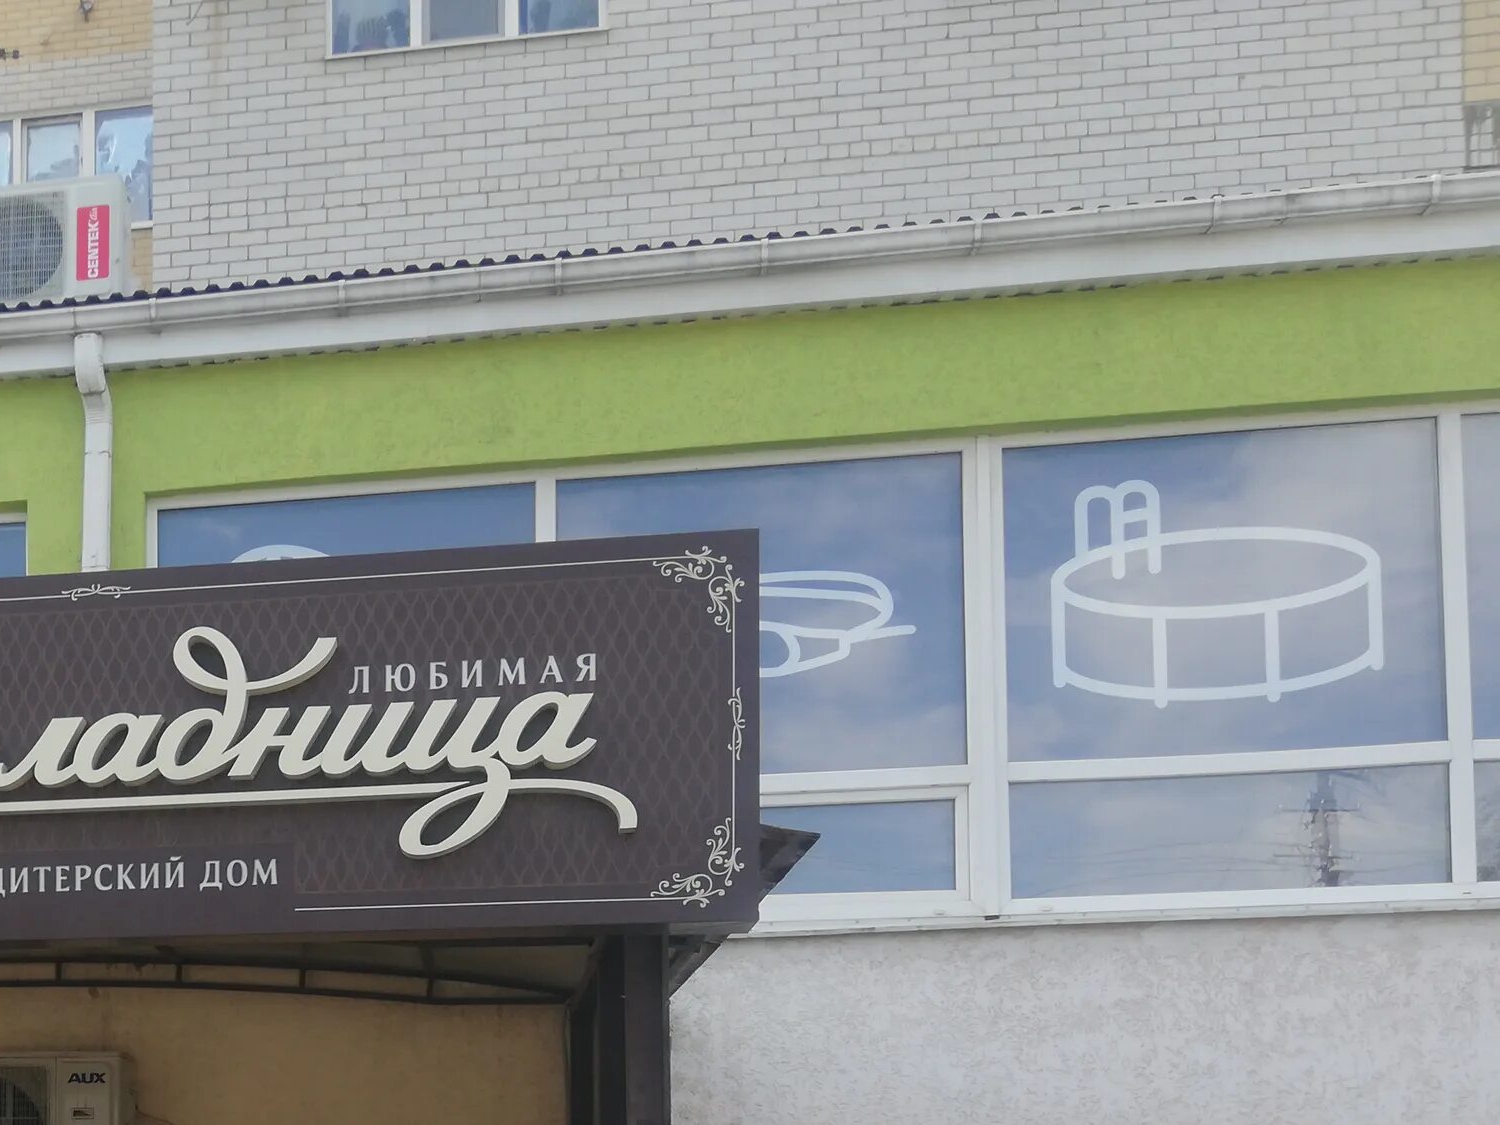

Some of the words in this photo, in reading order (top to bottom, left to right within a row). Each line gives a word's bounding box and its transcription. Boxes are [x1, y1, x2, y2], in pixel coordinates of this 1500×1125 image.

[87, 219, 99, 279] CENTEK
[348, 652, 598, 695] ЛЮБИМАЯ
[198, 857, 279, 892] ДОМ
[67, 1072, 106, 1083] AUX
